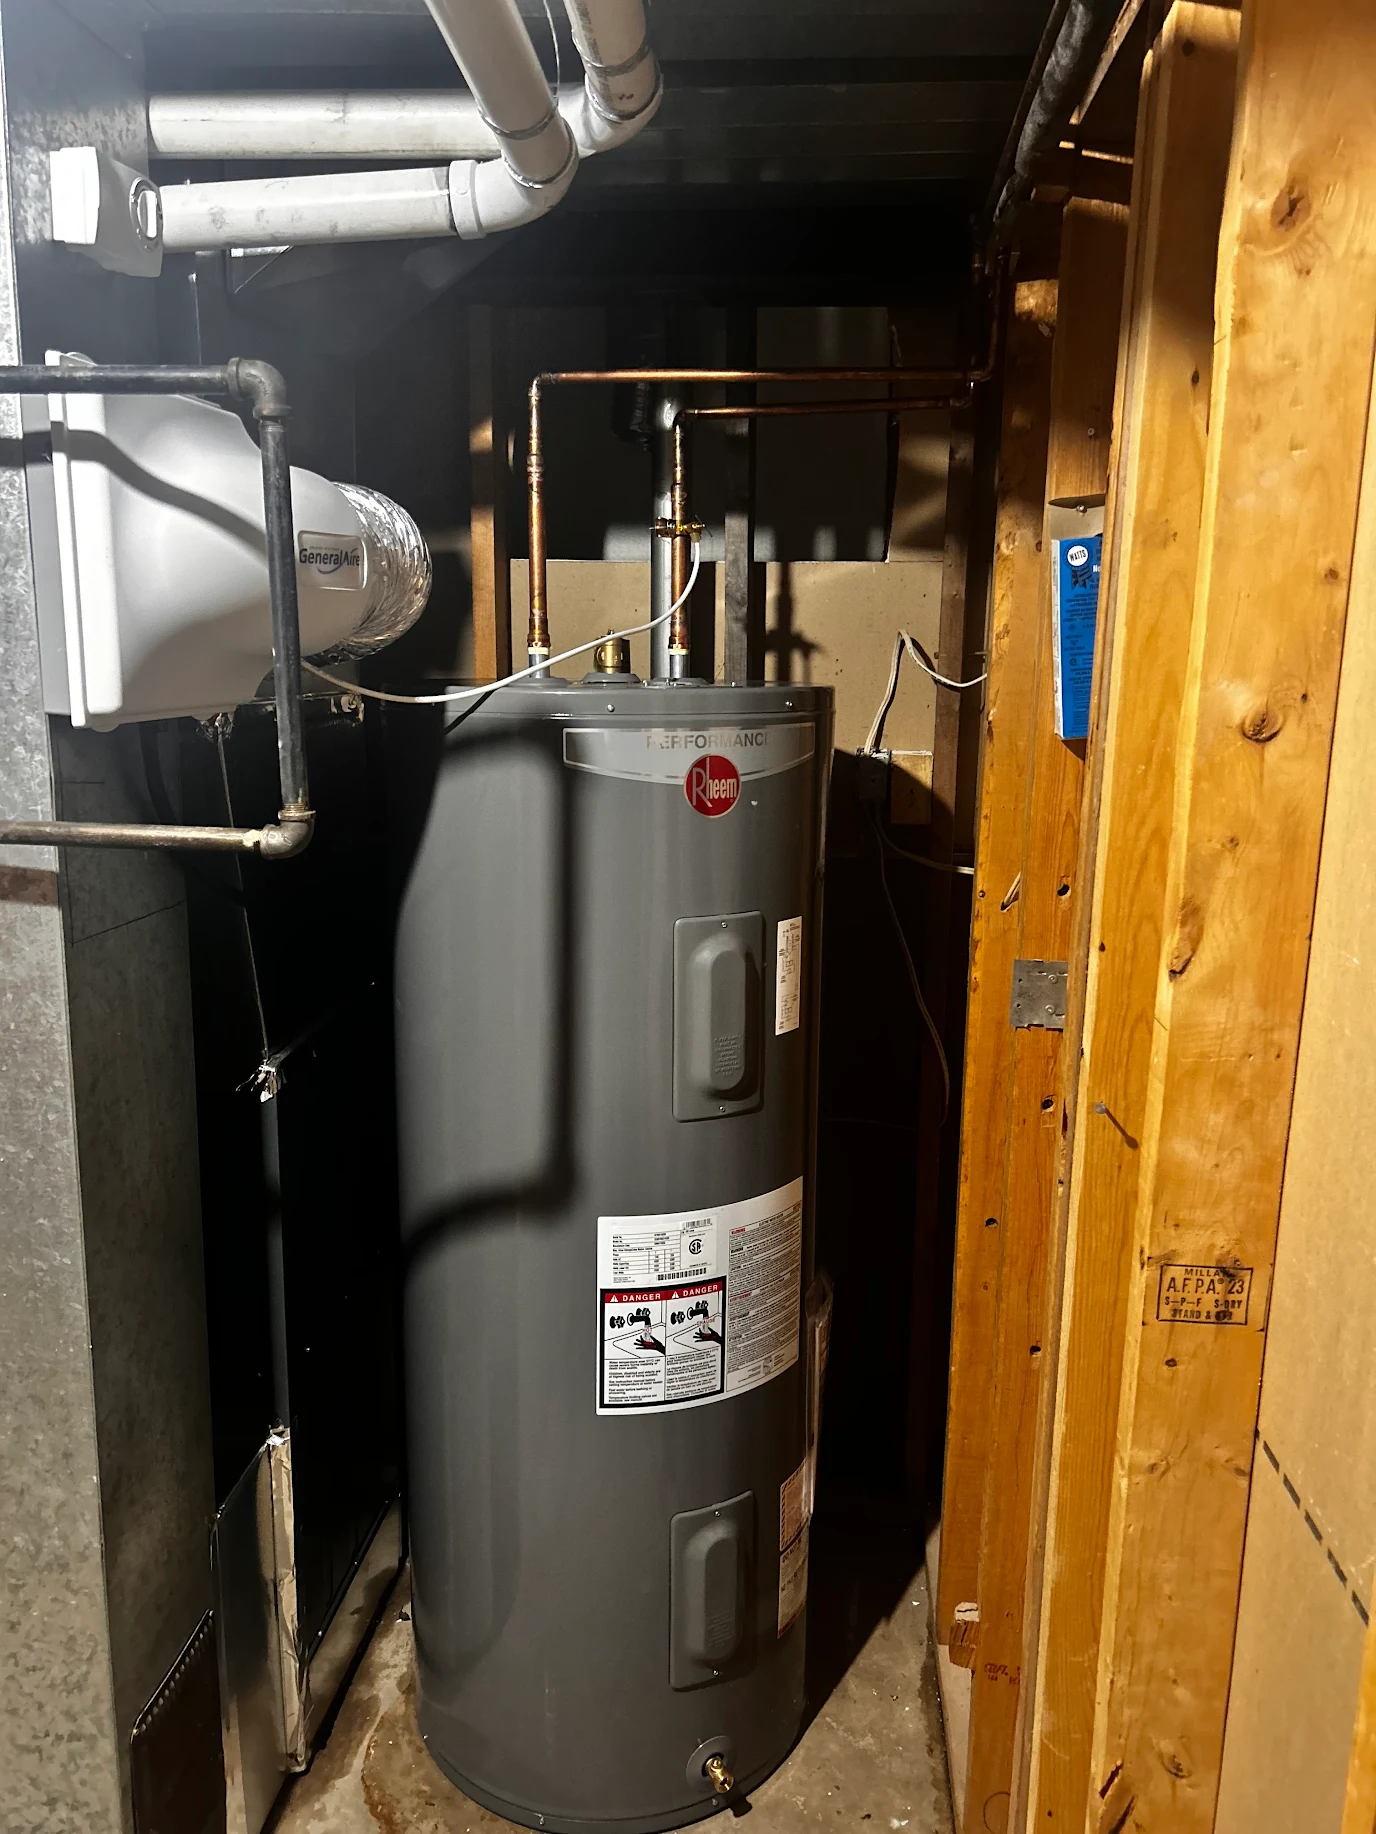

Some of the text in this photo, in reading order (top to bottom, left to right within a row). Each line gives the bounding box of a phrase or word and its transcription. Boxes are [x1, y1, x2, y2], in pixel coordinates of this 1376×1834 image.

[299, 548, 361, 566] GeneralAire
[1069, 549, 1087, 562] WATTS
[692, 757, 737, 808] Rheem
[1184, 1268, 1230, 1277] MILLA
[683, 1284, 718, 1298] DANGER
[1227, 1280, 1244, 1295] 23
[622, 1293, 661, 1303] DANGER
[1213, 1299, 1242, 1309] S-DRY
[1171, 1309, 1201, 1319] STAND
